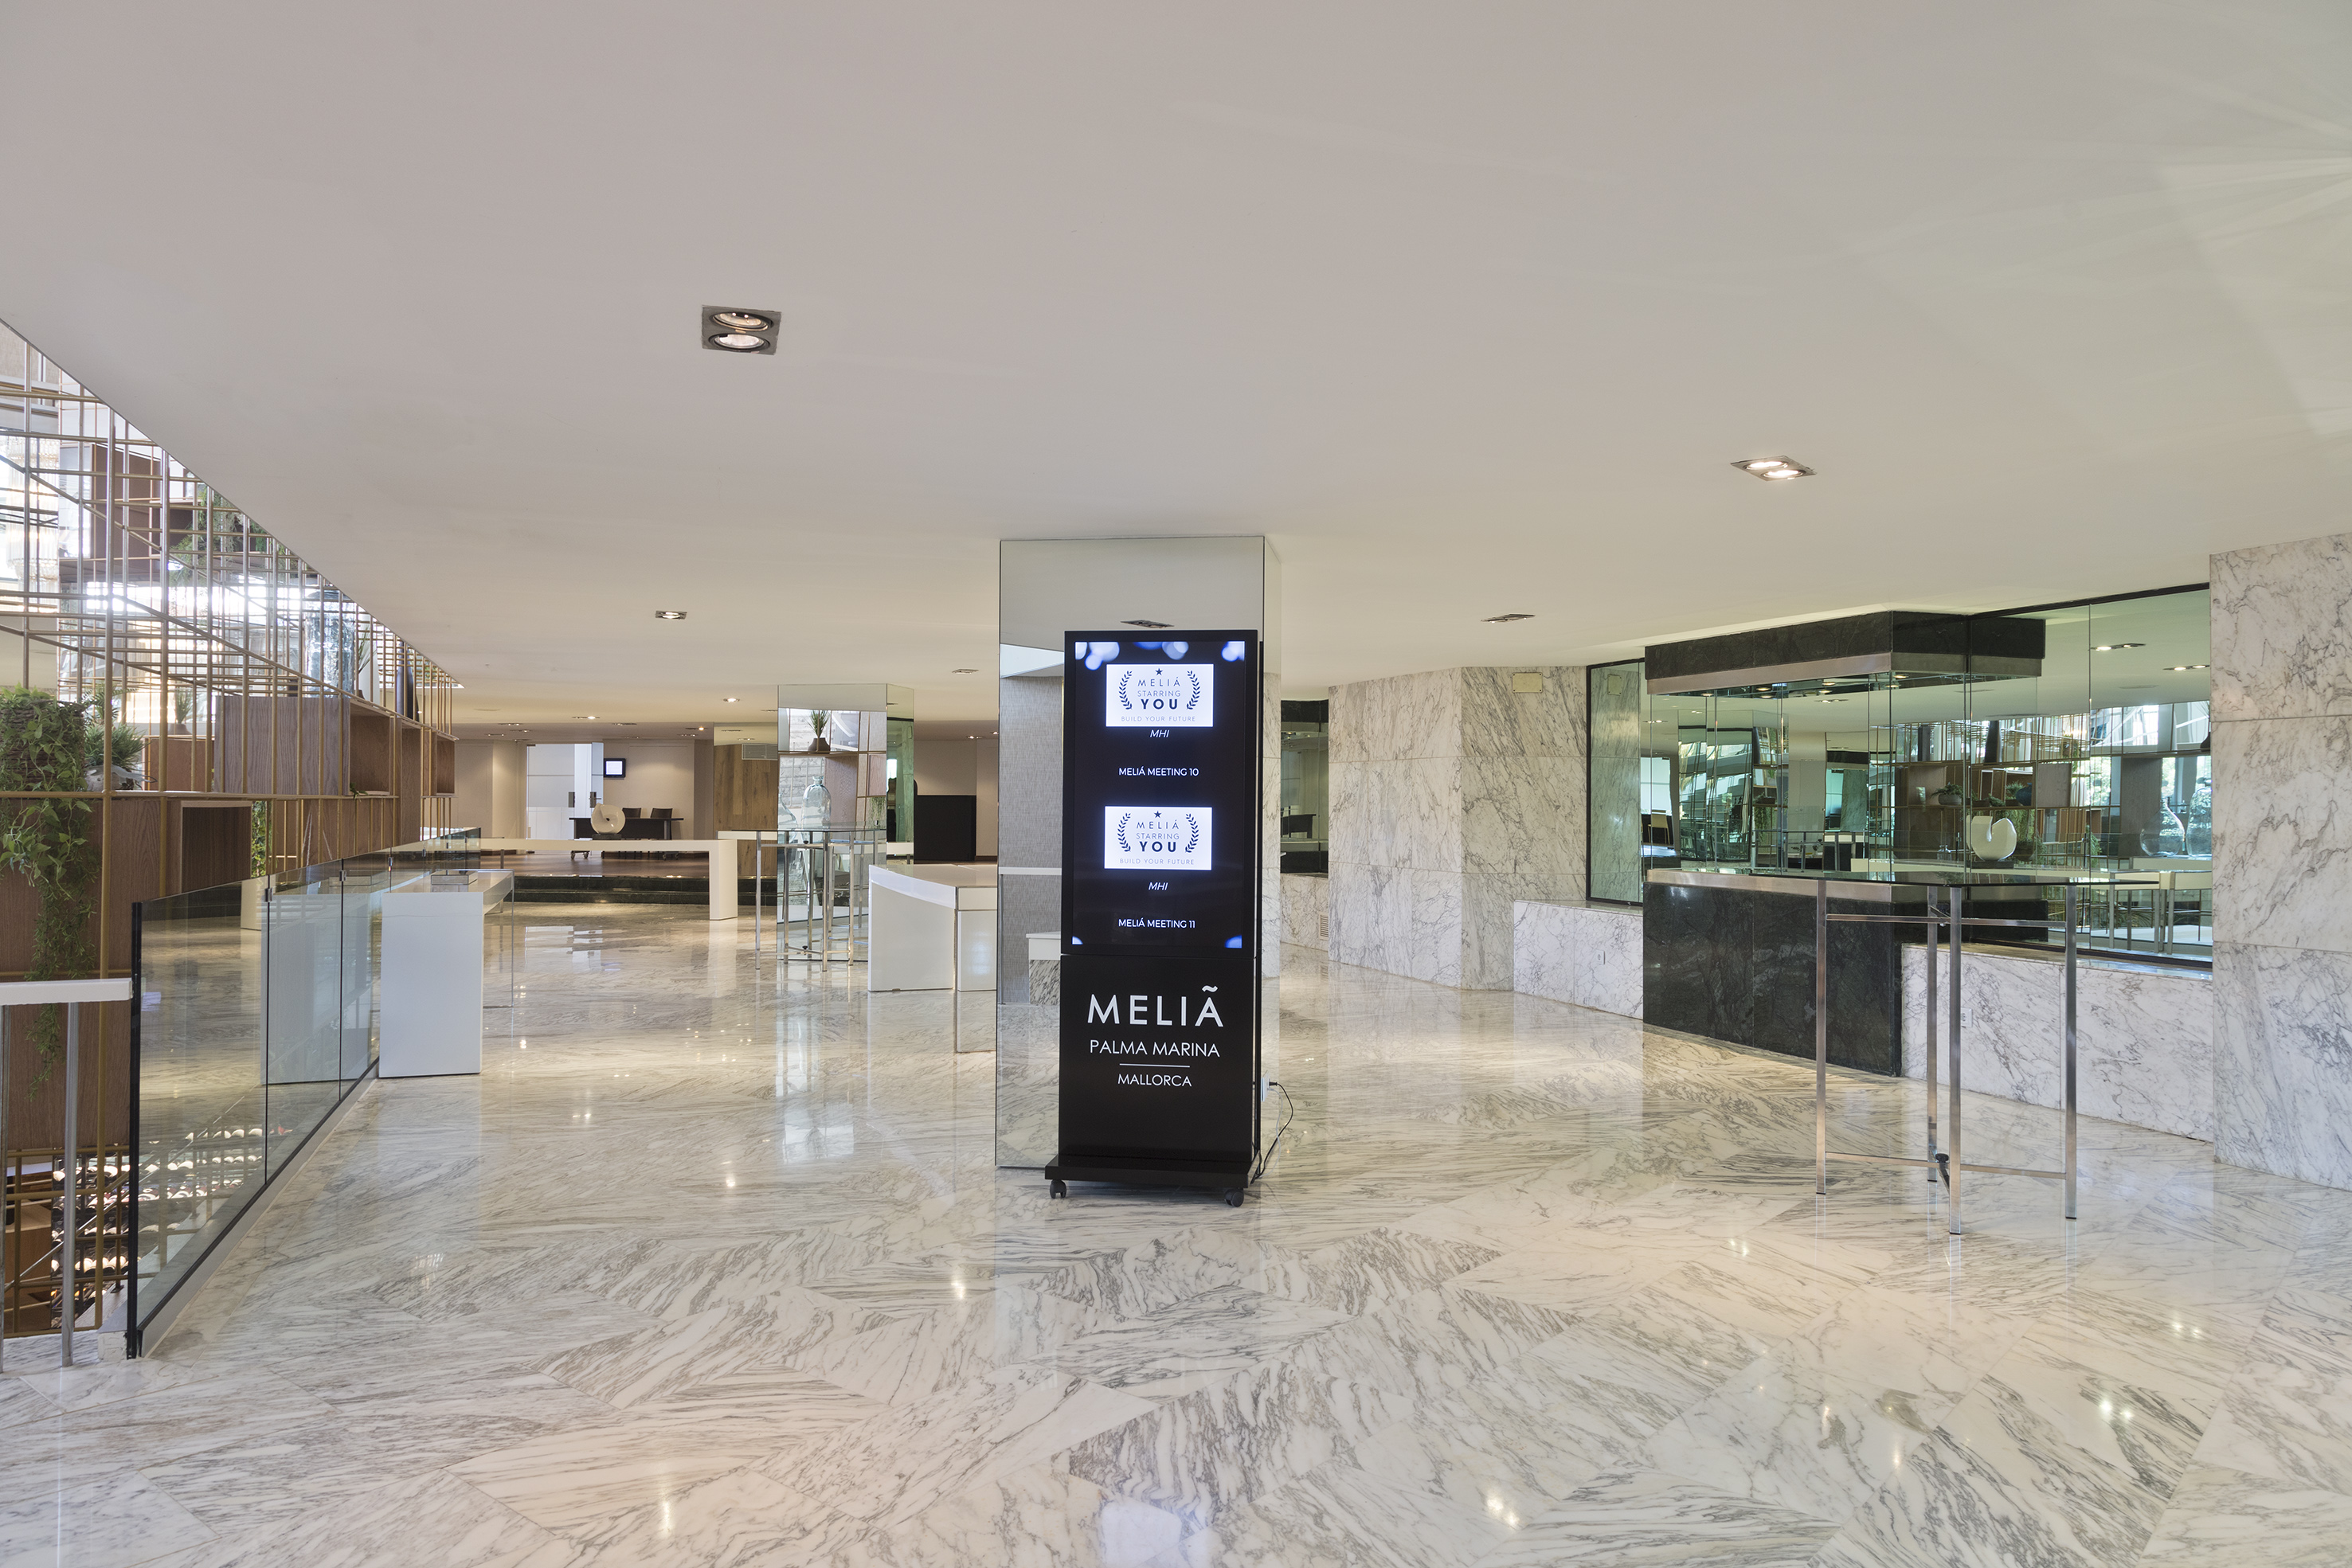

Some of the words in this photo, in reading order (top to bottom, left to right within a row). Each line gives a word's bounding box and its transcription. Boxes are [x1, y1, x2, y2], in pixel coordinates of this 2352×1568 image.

[1137, 676, 1180, 686] MELIÁ
[1141, 698, 1178, 710] YOU
[1118, 765, 1146, 776] MELIÁ
[1147, 768, 1188, 776] MEETING
[1189, 768, 1199, 776] 10
[1136, 819, 1179, 829] MELIÁ
[1139, 841, 1176, 852] YOU
[1148, 882, 1168, 890] MHI
[1118, 917, 1145, 928] MELIÁ
[1147, 919, 1187, 928] MEETING
[1090, 1039, 1148, 1055] PALMA
[1153, 1042, 1220, 1058] MARINA
[1117, 1073, 1192, 1087] MALLORCA
